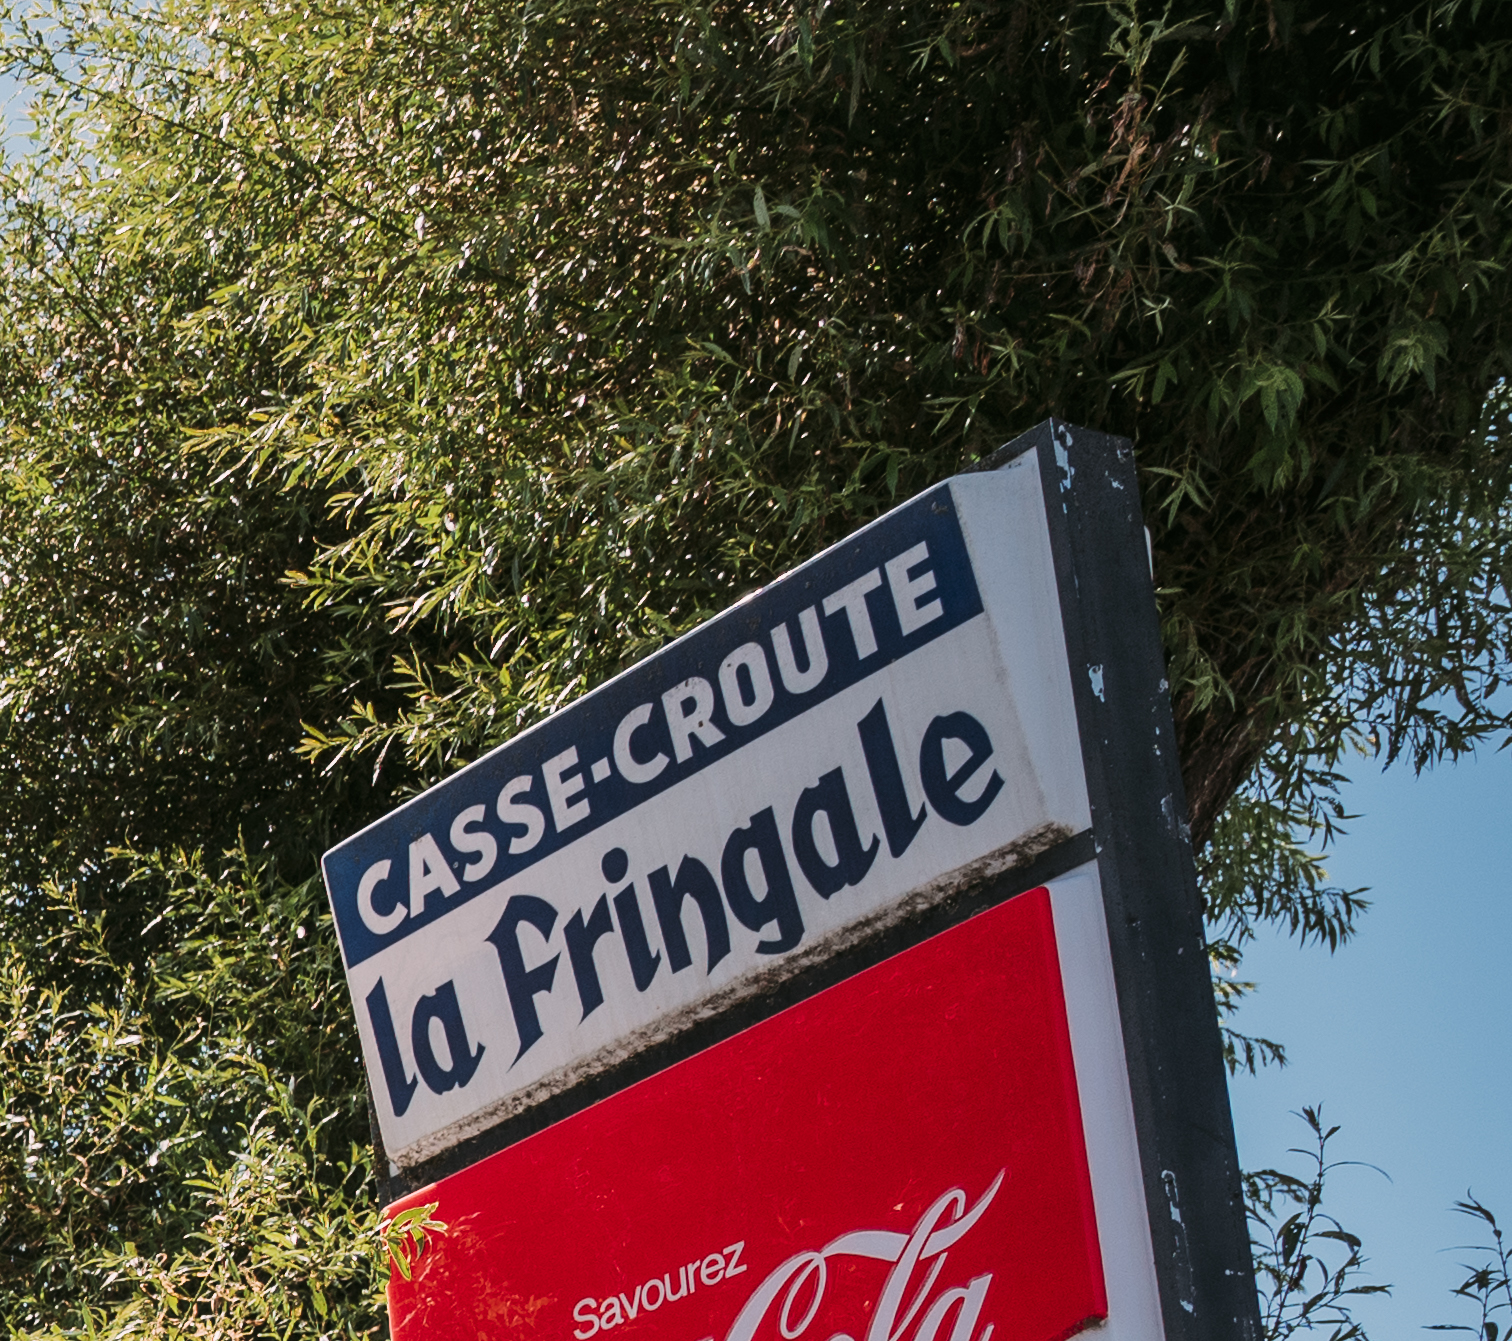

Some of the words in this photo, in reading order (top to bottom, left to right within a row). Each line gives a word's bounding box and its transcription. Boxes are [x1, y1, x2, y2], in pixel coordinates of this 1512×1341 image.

[357, 540, 944, 935] CASSE-CROUTE
[365, 976, 486, 1117] la
[573, 1240, 747, 1340] Savourez
